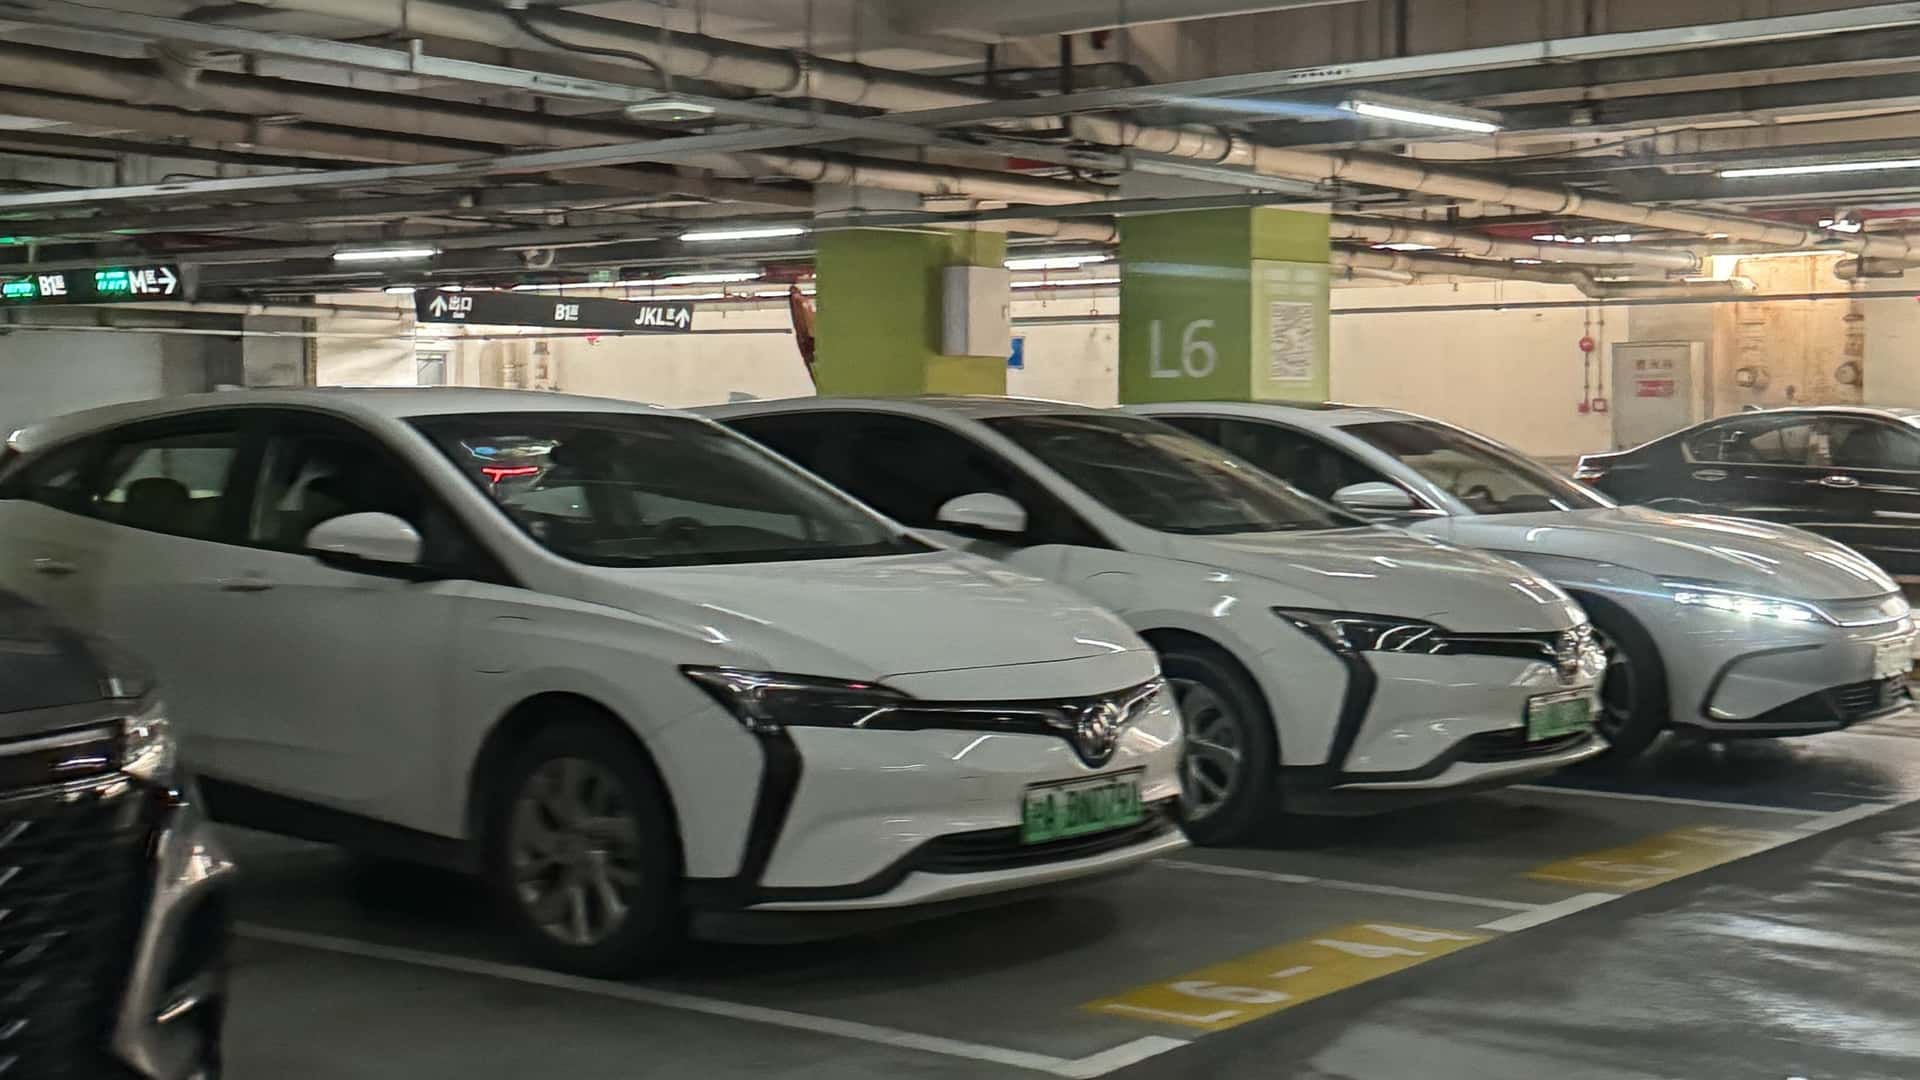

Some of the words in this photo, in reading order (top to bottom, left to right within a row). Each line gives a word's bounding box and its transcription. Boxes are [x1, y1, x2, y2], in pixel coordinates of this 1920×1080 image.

[448, 296, 472, 311] 出口
[1149, 319, 1217, 378] L6
[1103, 924, 1473, 1023] L6-44
